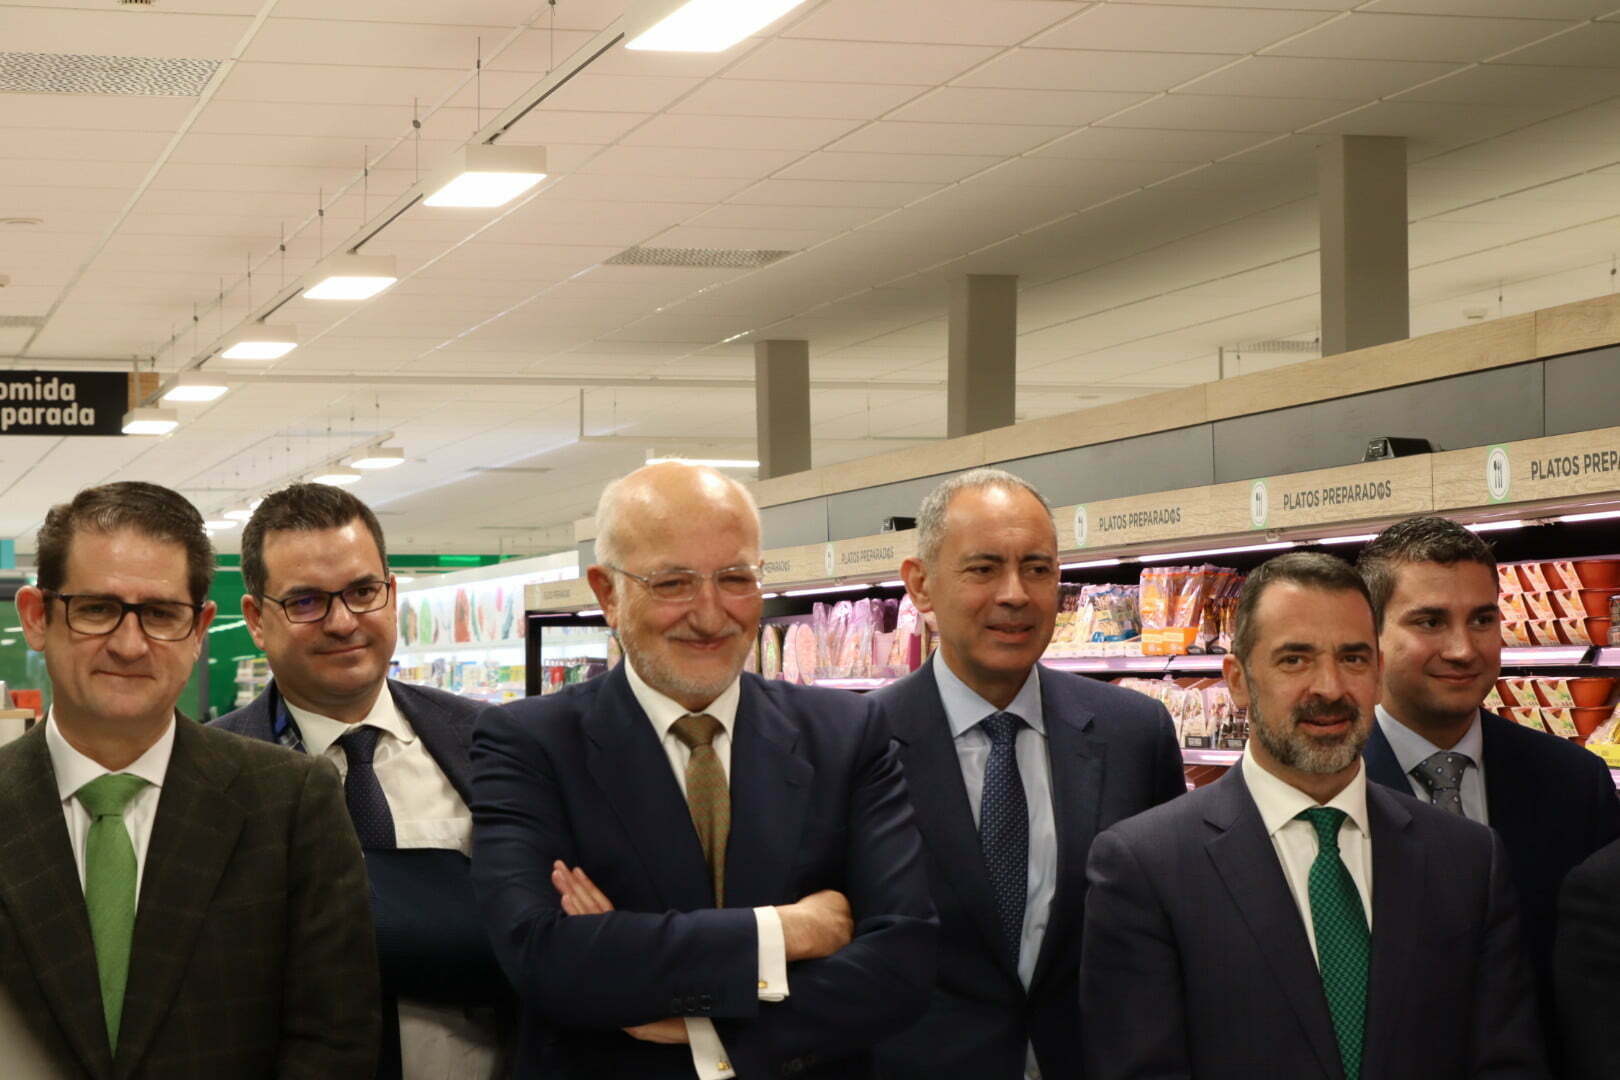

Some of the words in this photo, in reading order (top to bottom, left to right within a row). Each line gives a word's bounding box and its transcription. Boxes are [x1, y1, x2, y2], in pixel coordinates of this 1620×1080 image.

[1, 403, 95, 431] parada
[1531, 455, 1580, 480] PLATOS
[1584, 450, 1620, 474] PREP
[1283, 490, 1319, 511] PLATOS
[1322, 480, 1391, 506] PREPARADOS
[1099, 514, 1127, 532] PLATOS
[1128, 507, 1181, 529] PREPARADOS
